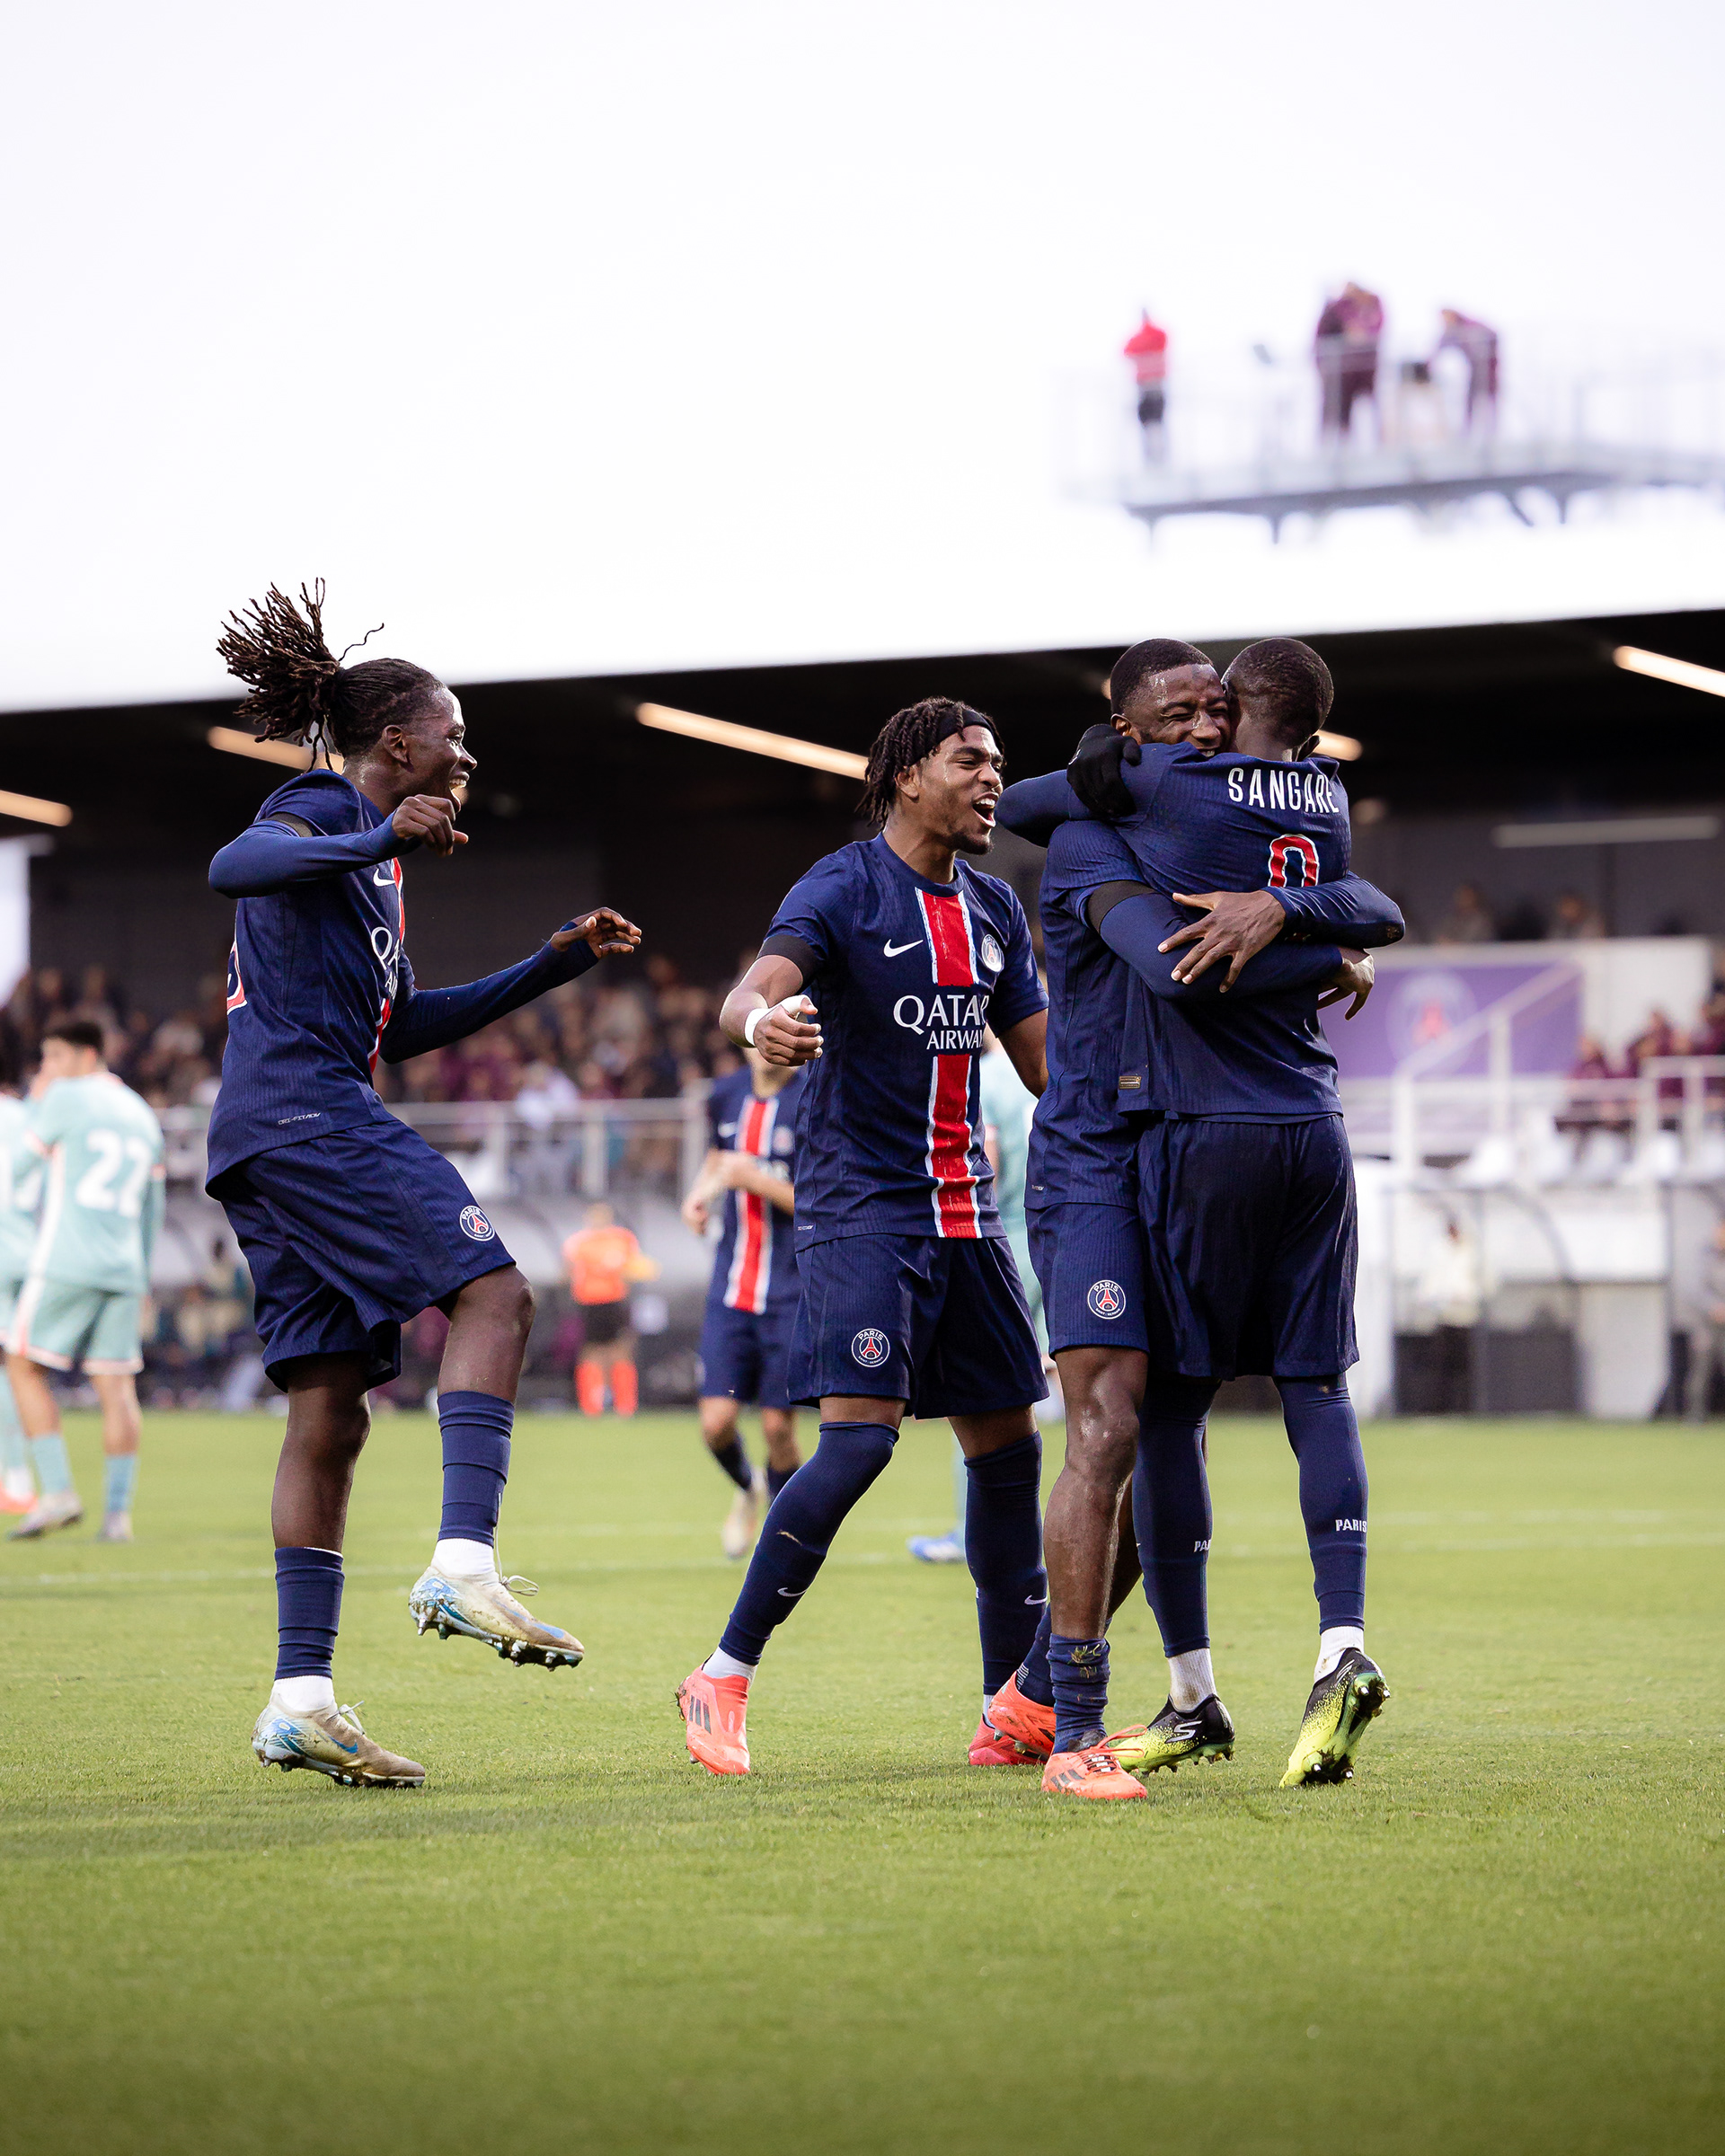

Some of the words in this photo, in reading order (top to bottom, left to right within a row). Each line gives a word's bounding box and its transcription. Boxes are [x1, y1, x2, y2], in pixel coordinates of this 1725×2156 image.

[1227, 767, 1340, 813] SANGARE
[1093, 1282, 1119, 1293] PARIS
[858, 1330, 884, 1341] PARIS
[1335, 1518, 1367, 1533] PARIS
